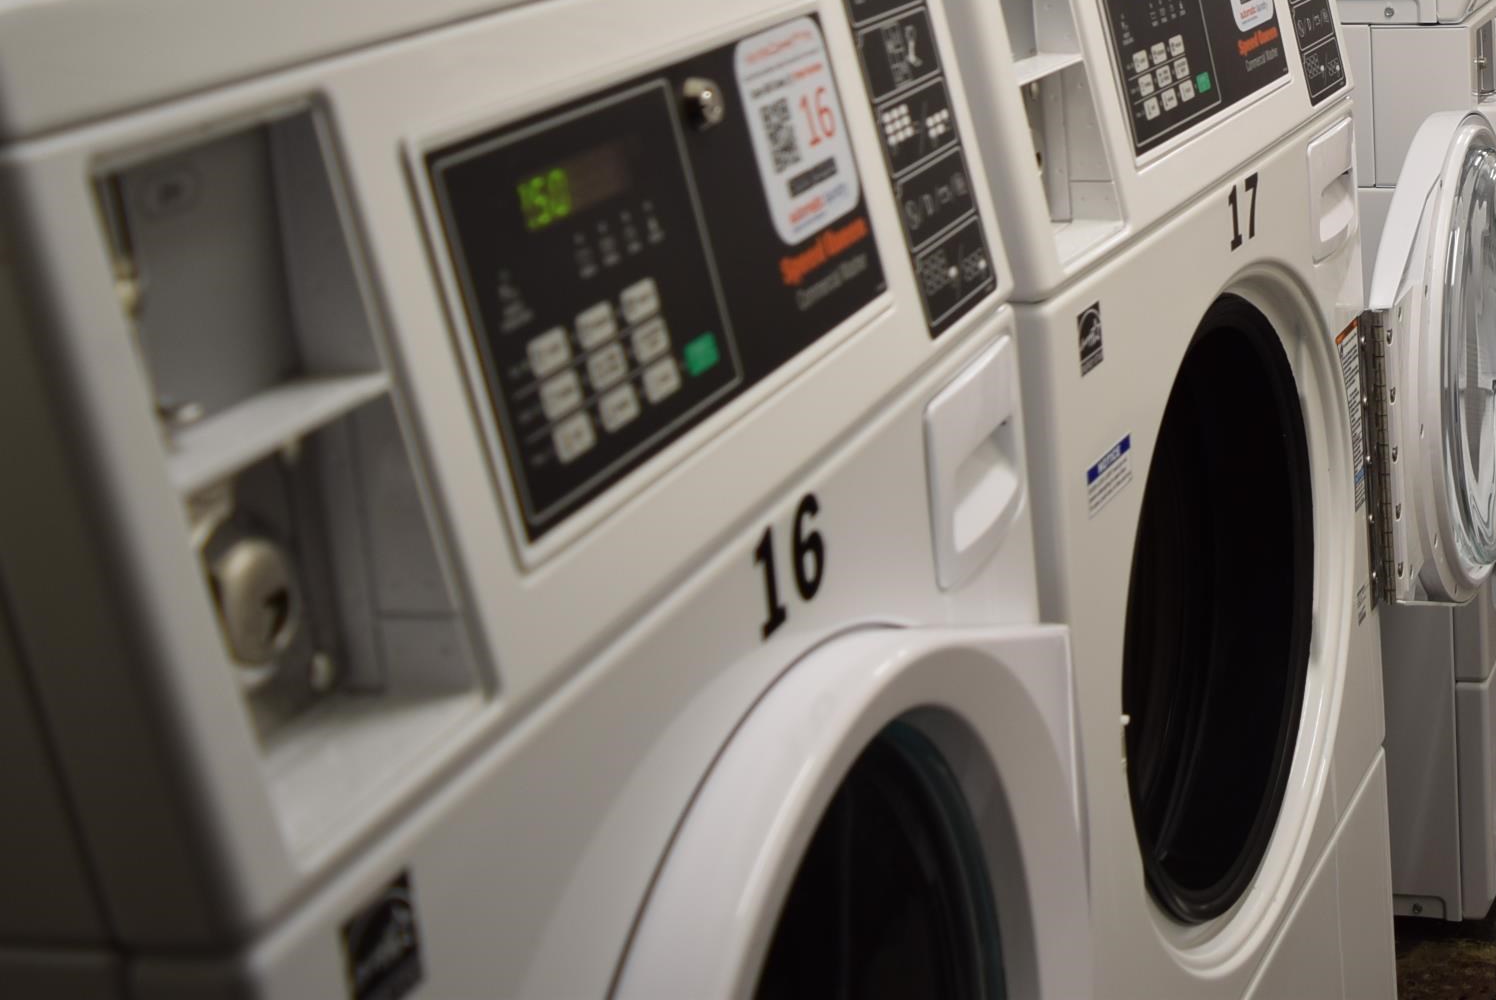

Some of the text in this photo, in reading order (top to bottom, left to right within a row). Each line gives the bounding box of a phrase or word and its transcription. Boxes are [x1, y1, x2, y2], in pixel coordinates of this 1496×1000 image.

[1238, 26, 1279, 57] Speed Queen
[799, 85, 837, 148] 16
[1228, 171, 1258, 252] 17
[754, 492, 825, 644] 16
